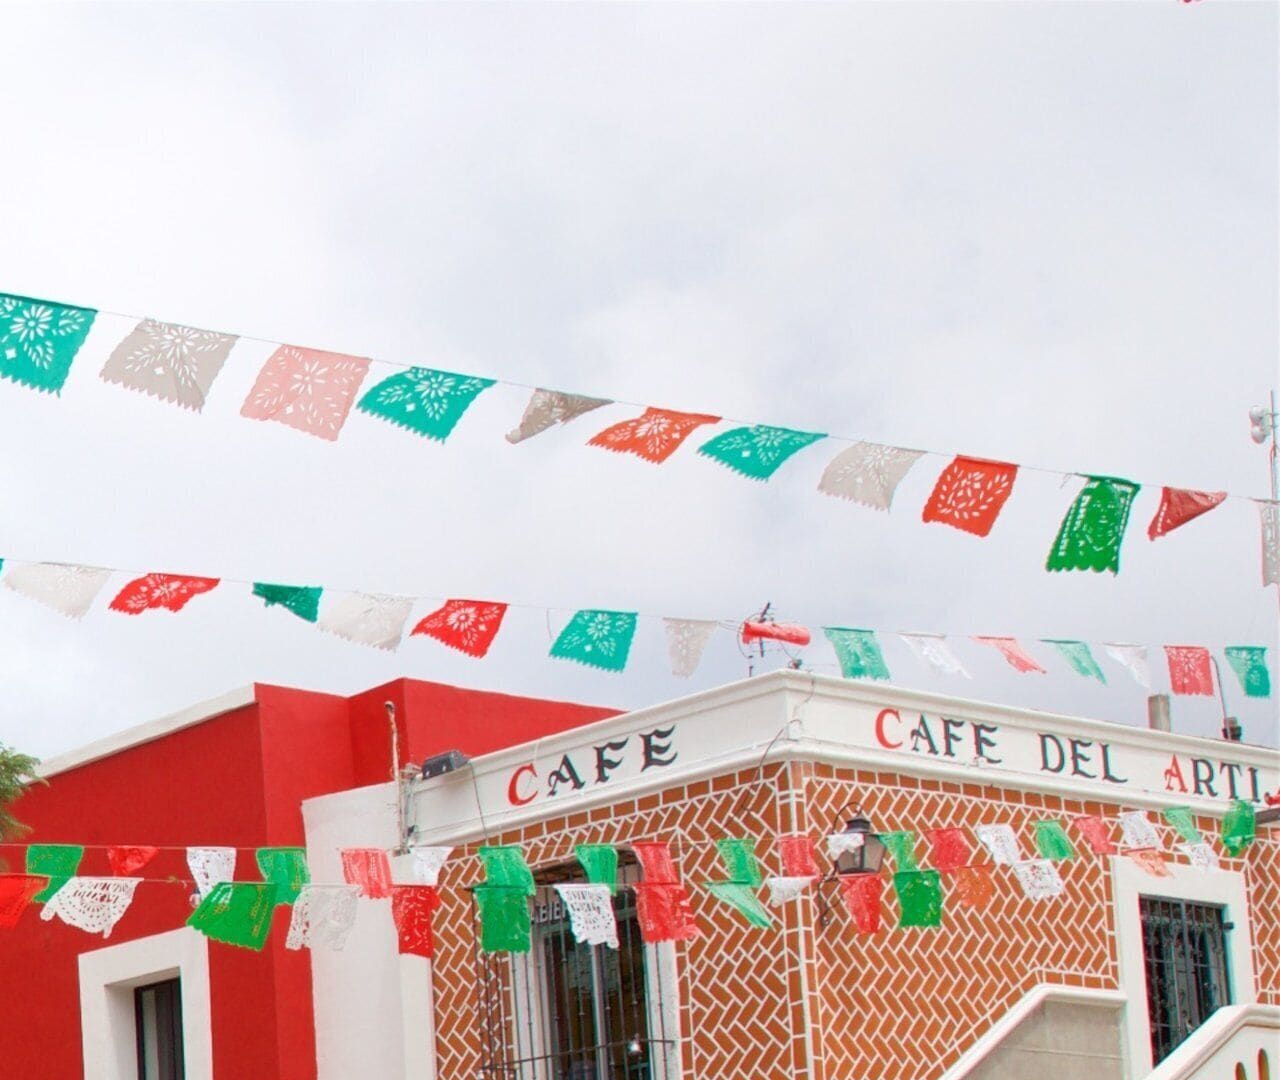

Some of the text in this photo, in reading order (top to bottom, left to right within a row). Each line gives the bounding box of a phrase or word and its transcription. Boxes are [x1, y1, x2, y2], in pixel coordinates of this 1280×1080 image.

[507, 724, 679, 808] CAFE
[875, 708, 1002, 764] CAFE
[1039, 732, 1127, 785] DEL
